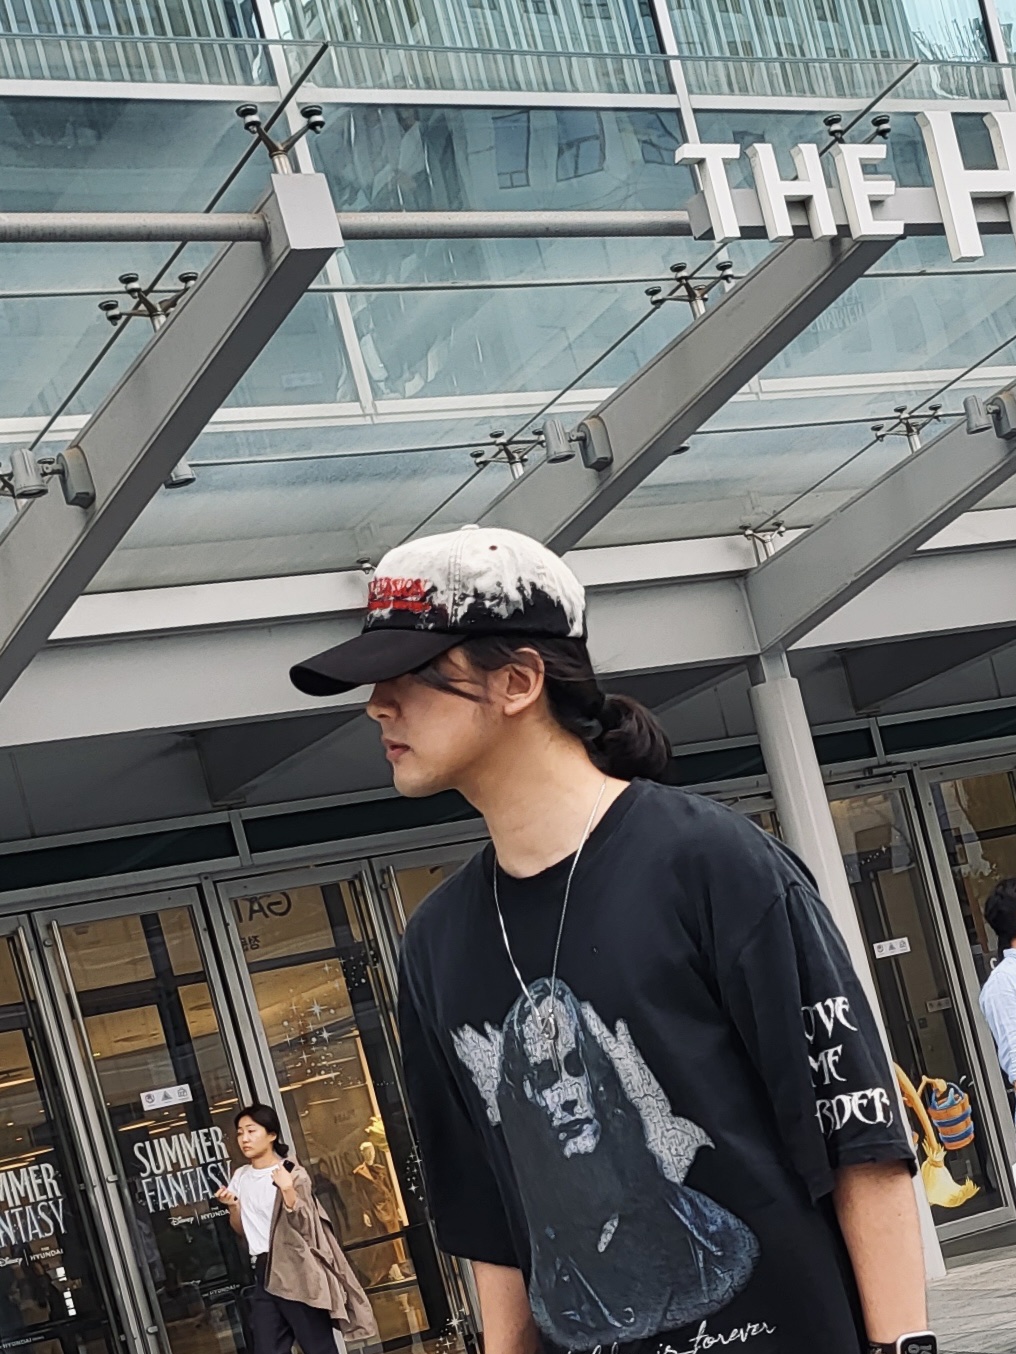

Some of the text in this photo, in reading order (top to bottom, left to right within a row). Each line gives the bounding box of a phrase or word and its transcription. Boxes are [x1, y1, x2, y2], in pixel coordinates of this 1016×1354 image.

[675, 143, 904, 242] THE
[801, 996, 858, 1045] OVE
[133, 1125, 230, 1178] SUMMER
[0, 1162, 62, 1208] MMER
[141, 1159, 233, 1214] FANTASY
[0, 1198, 67, 1248] NTASY
[200, 1209, 230, 1220] HYUNDA
